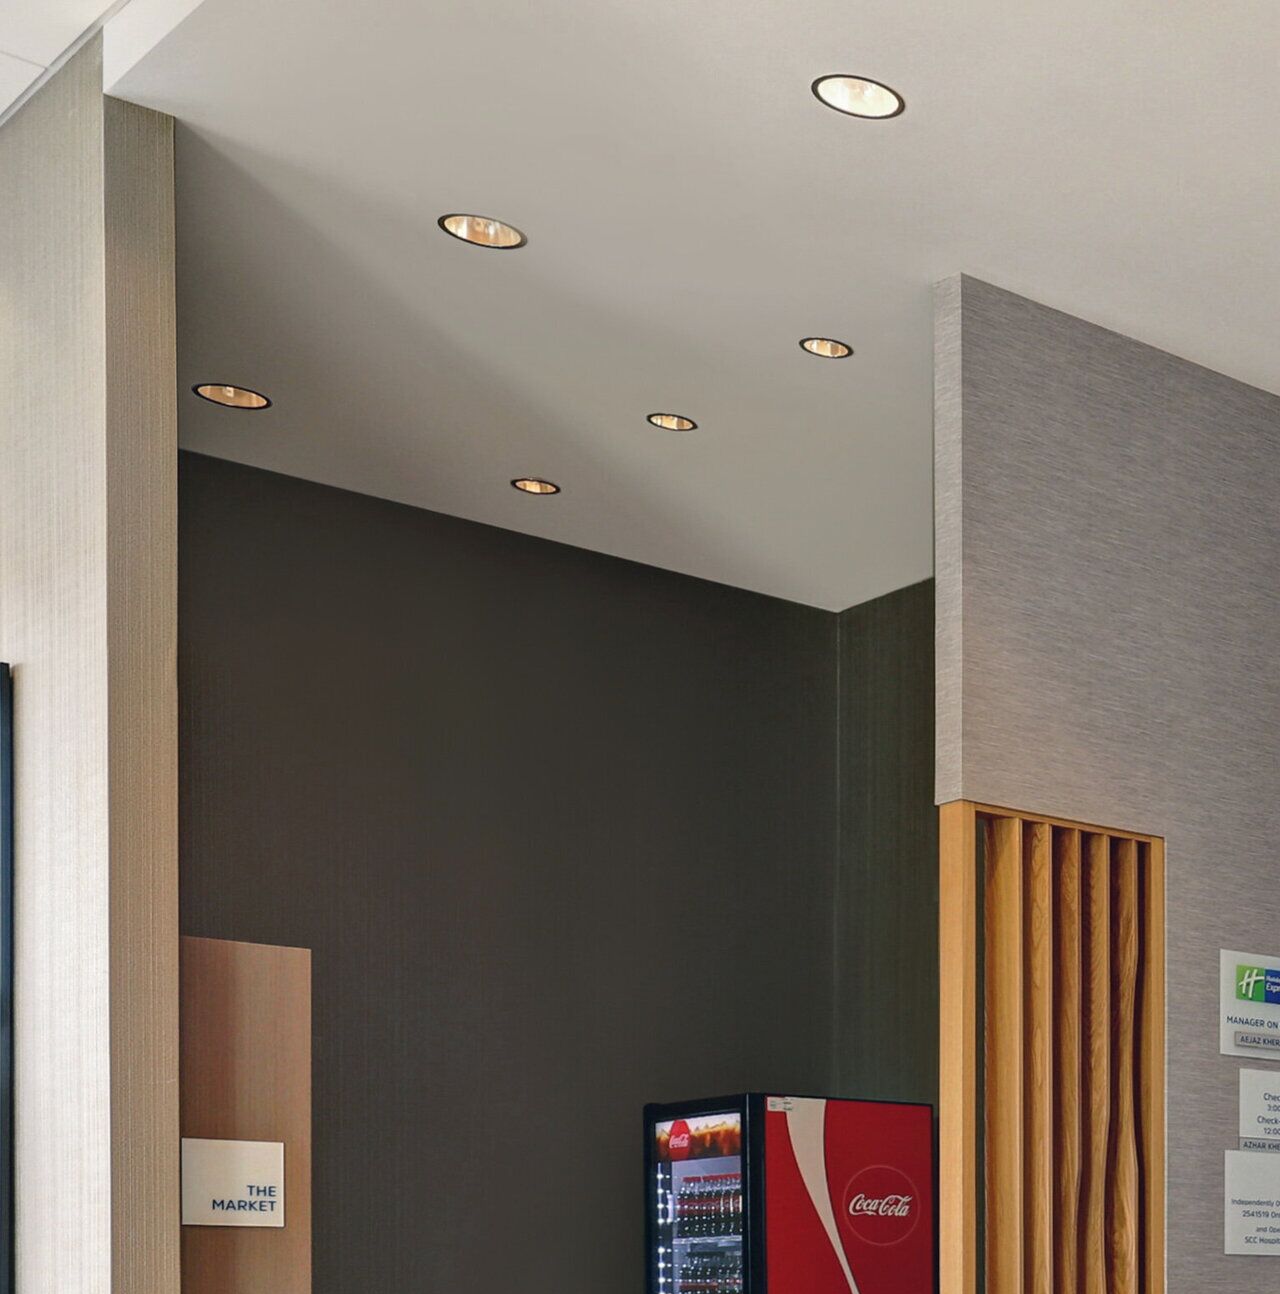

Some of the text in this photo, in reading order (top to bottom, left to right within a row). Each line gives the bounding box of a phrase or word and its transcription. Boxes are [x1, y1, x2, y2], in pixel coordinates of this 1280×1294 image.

[1227, 1016, 1265, 1027] MANAGER
[1267, 1020, 1279, 1029] ON
[247, 1184, 277, 1197] THE
[212, 1199, 277, 1211] MARKET
[848, 1193, 913, 1216] Coca-Cola
